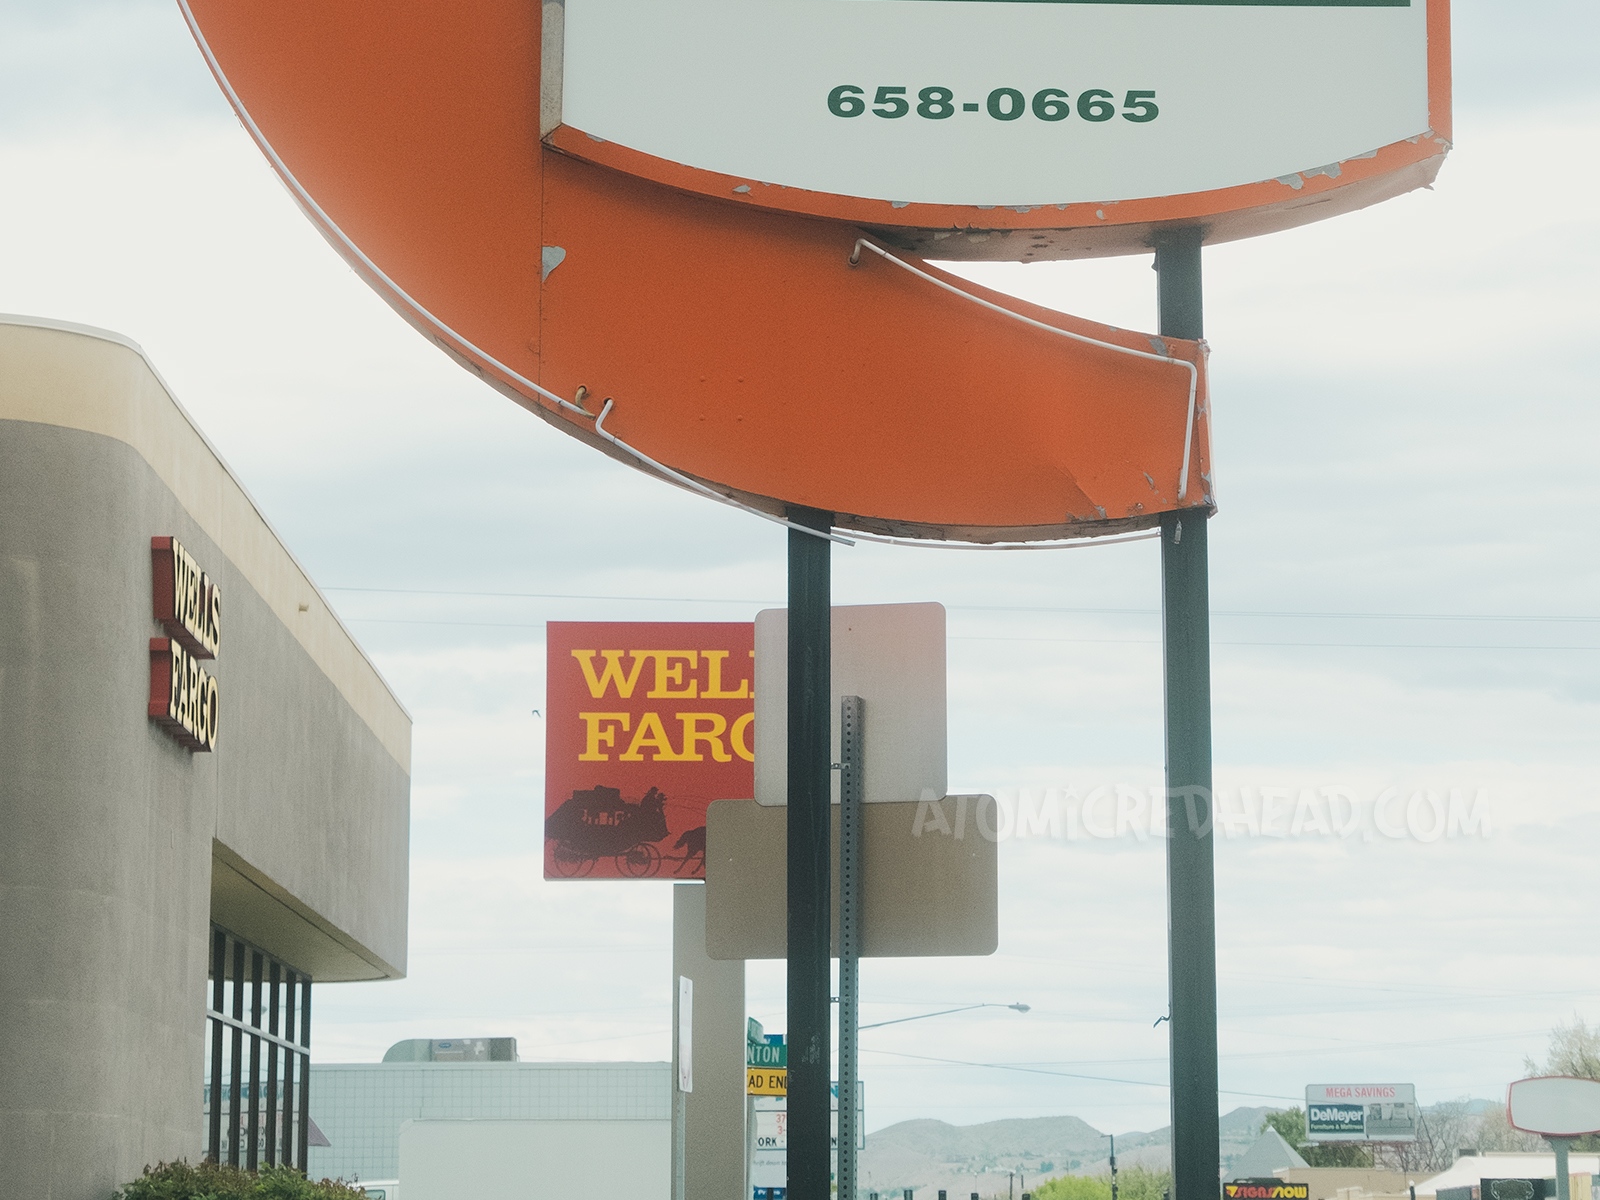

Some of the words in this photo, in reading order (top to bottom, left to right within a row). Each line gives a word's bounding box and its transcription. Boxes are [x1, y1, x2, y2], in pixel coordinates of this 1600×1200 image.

[827, 84, 1161, 123] 658-0665
[172, 536, 221, 659] WELLS
[571, 649, 754, 699] WEL
[170, 638, 219, 751] FARGO
[747, 1075, 764, 1088] AD
[1326, 1087, 1352, 1098] MEGA
[1355, 1087, 1396, 1098] SAVINGS
[1310, 1108, 1363, 1123] DeMeyer
